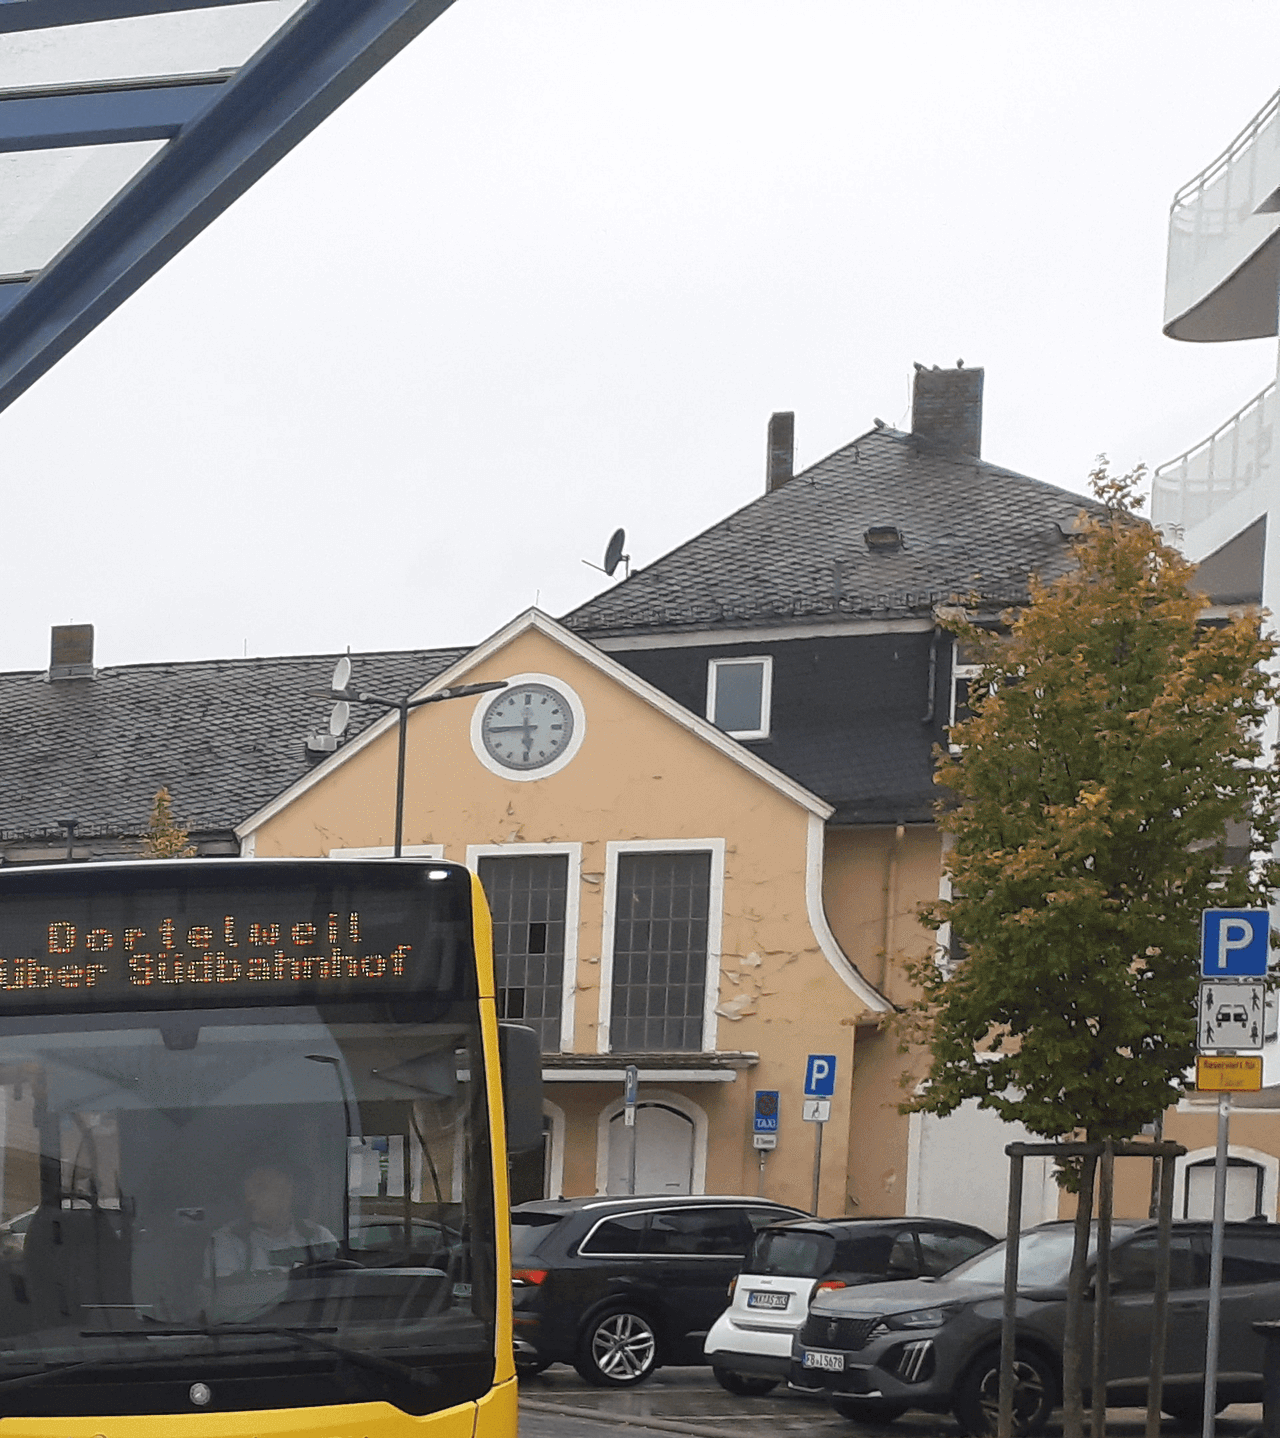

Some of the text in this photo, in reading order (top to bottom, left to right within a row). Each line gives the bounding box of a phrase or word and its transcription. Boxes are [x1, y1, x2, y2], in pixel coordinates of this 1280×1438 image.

[48, 911, 361, 952] Dortelweil
[1218, 918, 1253, 968] P
[129, 944, 411, 985] Südbahnhof
[811, 1059, 829, 1090] P
[756, 1119, 776, 1128] TAXI
